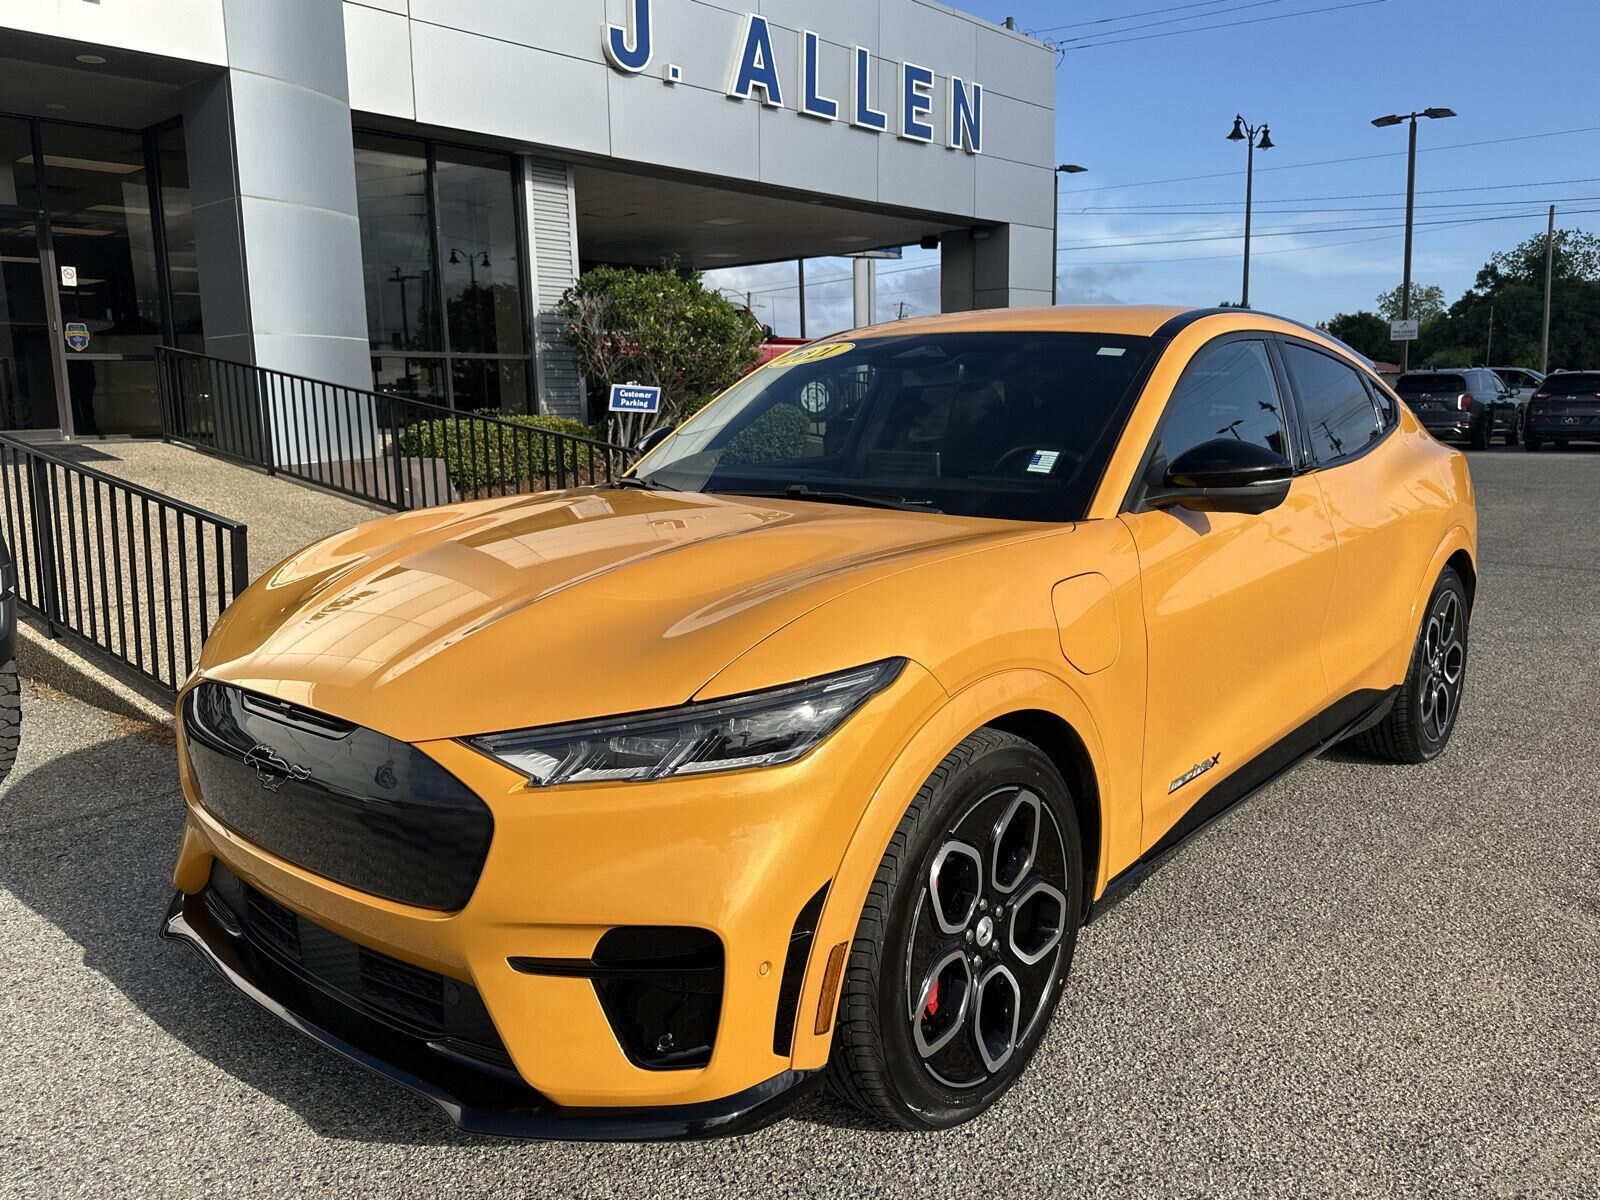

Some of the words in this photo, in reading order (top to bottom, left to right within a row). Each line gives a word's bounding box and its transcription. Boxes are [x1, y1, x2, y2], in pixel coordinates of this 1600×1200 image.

[602, 0, 682, 83] J.
[727, 13, 983, 154] ALLEN
[619, 389, 652, 399] Customer
[620, 399, 649, 408] Parking
